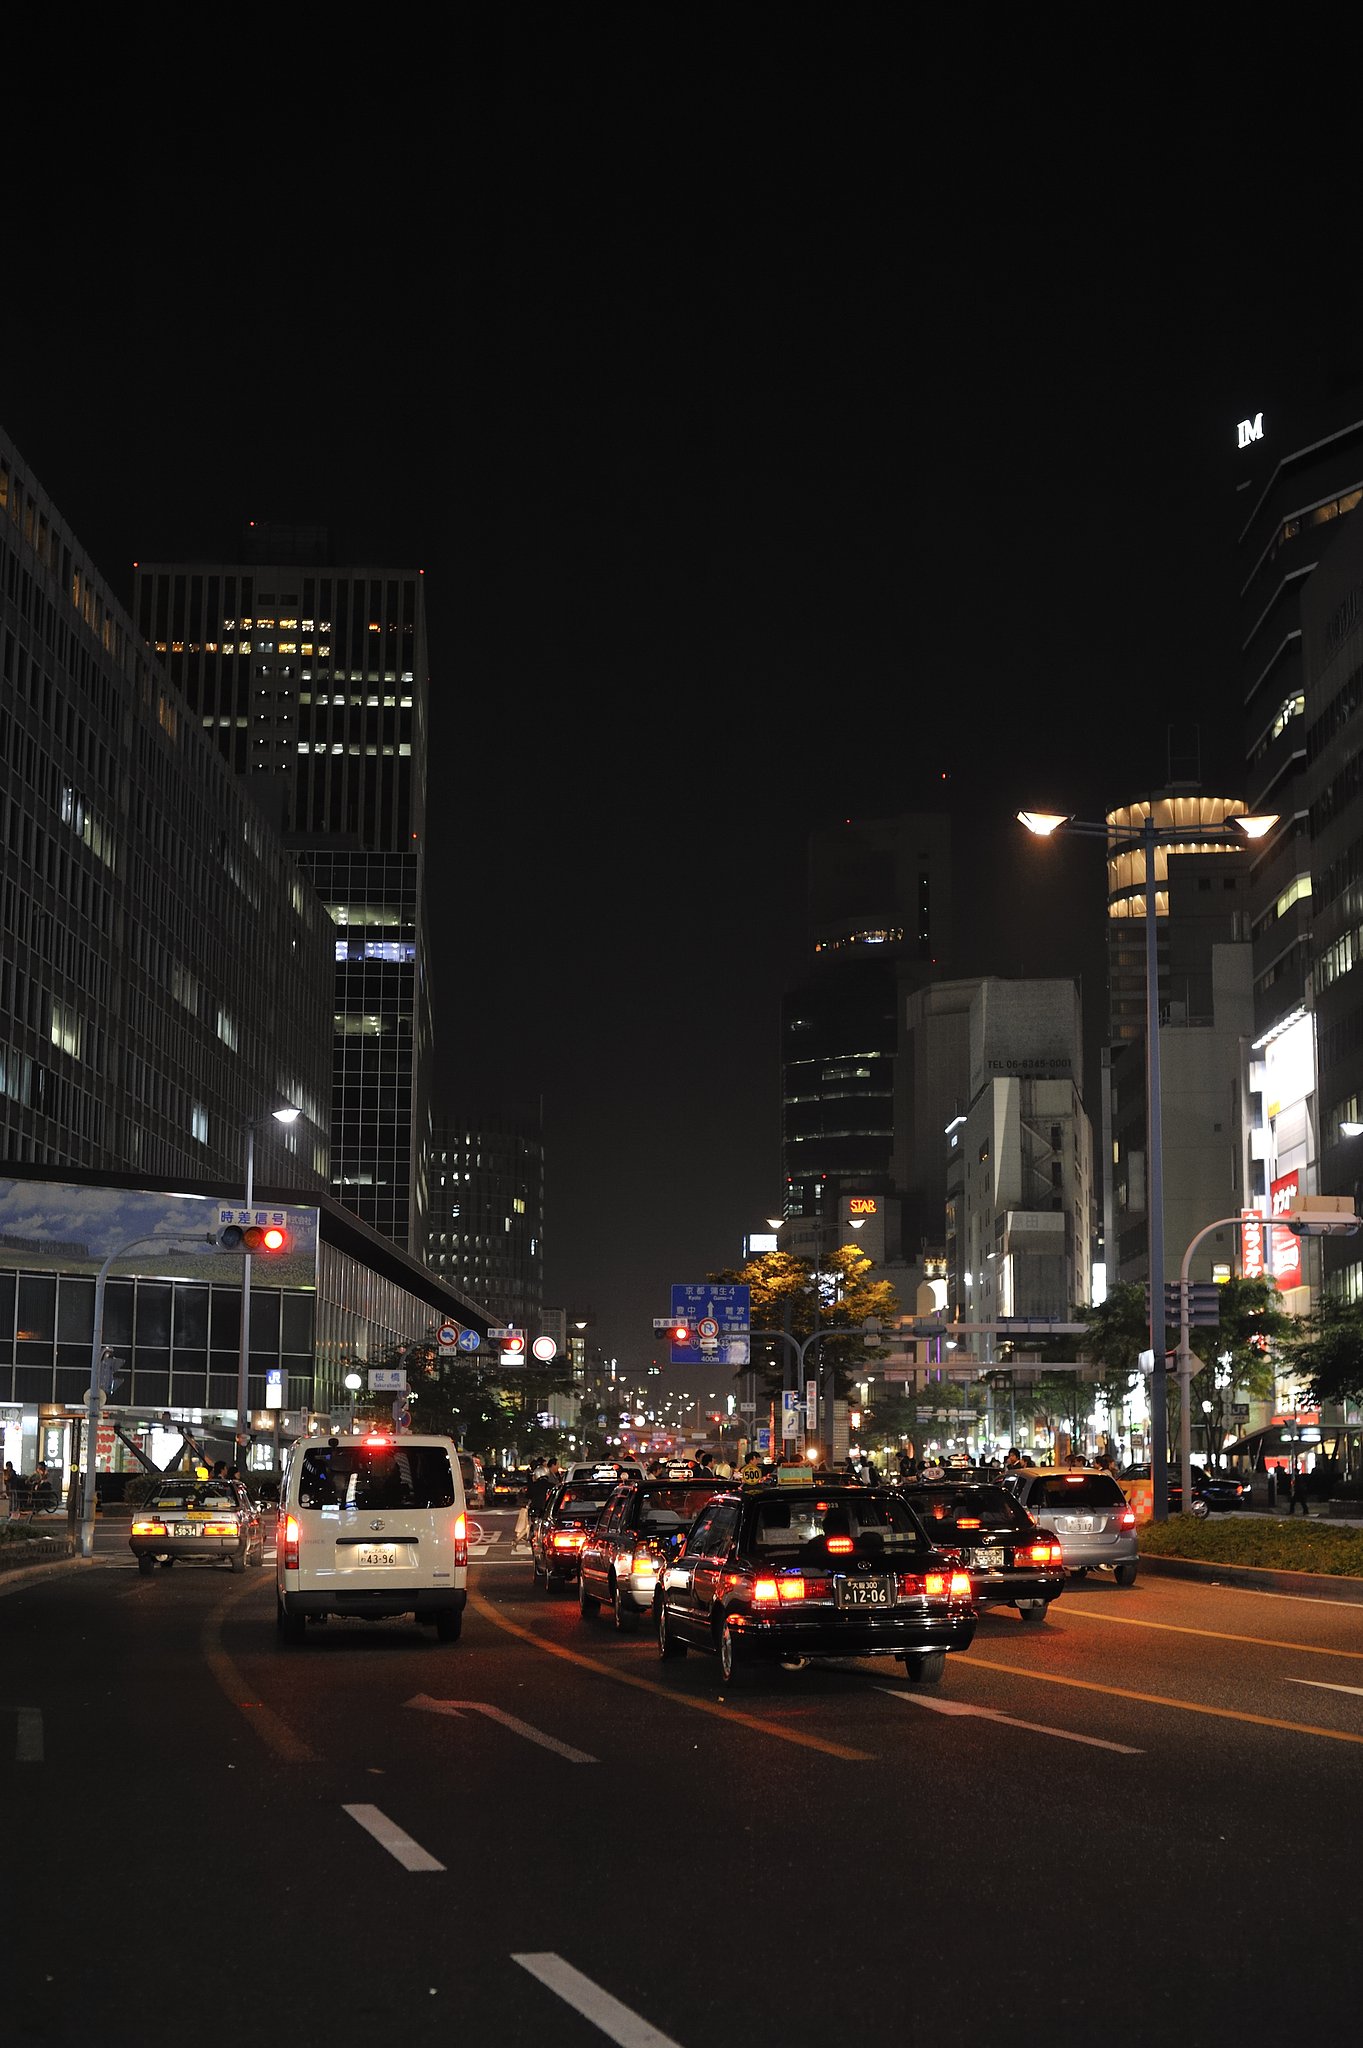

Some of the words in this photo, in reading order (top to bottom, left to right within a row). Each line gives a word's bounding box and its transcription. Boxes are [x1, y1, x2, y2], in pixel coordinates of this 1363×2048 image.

[987, 1060, 1004, 1069] TEL
[850, 1199, 877, 1213] STAR
[221, 1211, 285, 1225] 時差信号
[1244, 1212, 1262, 1279] カラオケ
[685, 1286, 705, 1296] 京都
[268, 1371, 281, 1384] JR
[1232, 1405, 1248, 1414] JR
[744, 1470, 760, 1480] 500
[366, 1554, 394, 1564] 43-96
[853, 1589, 886, 1603] 12-06
